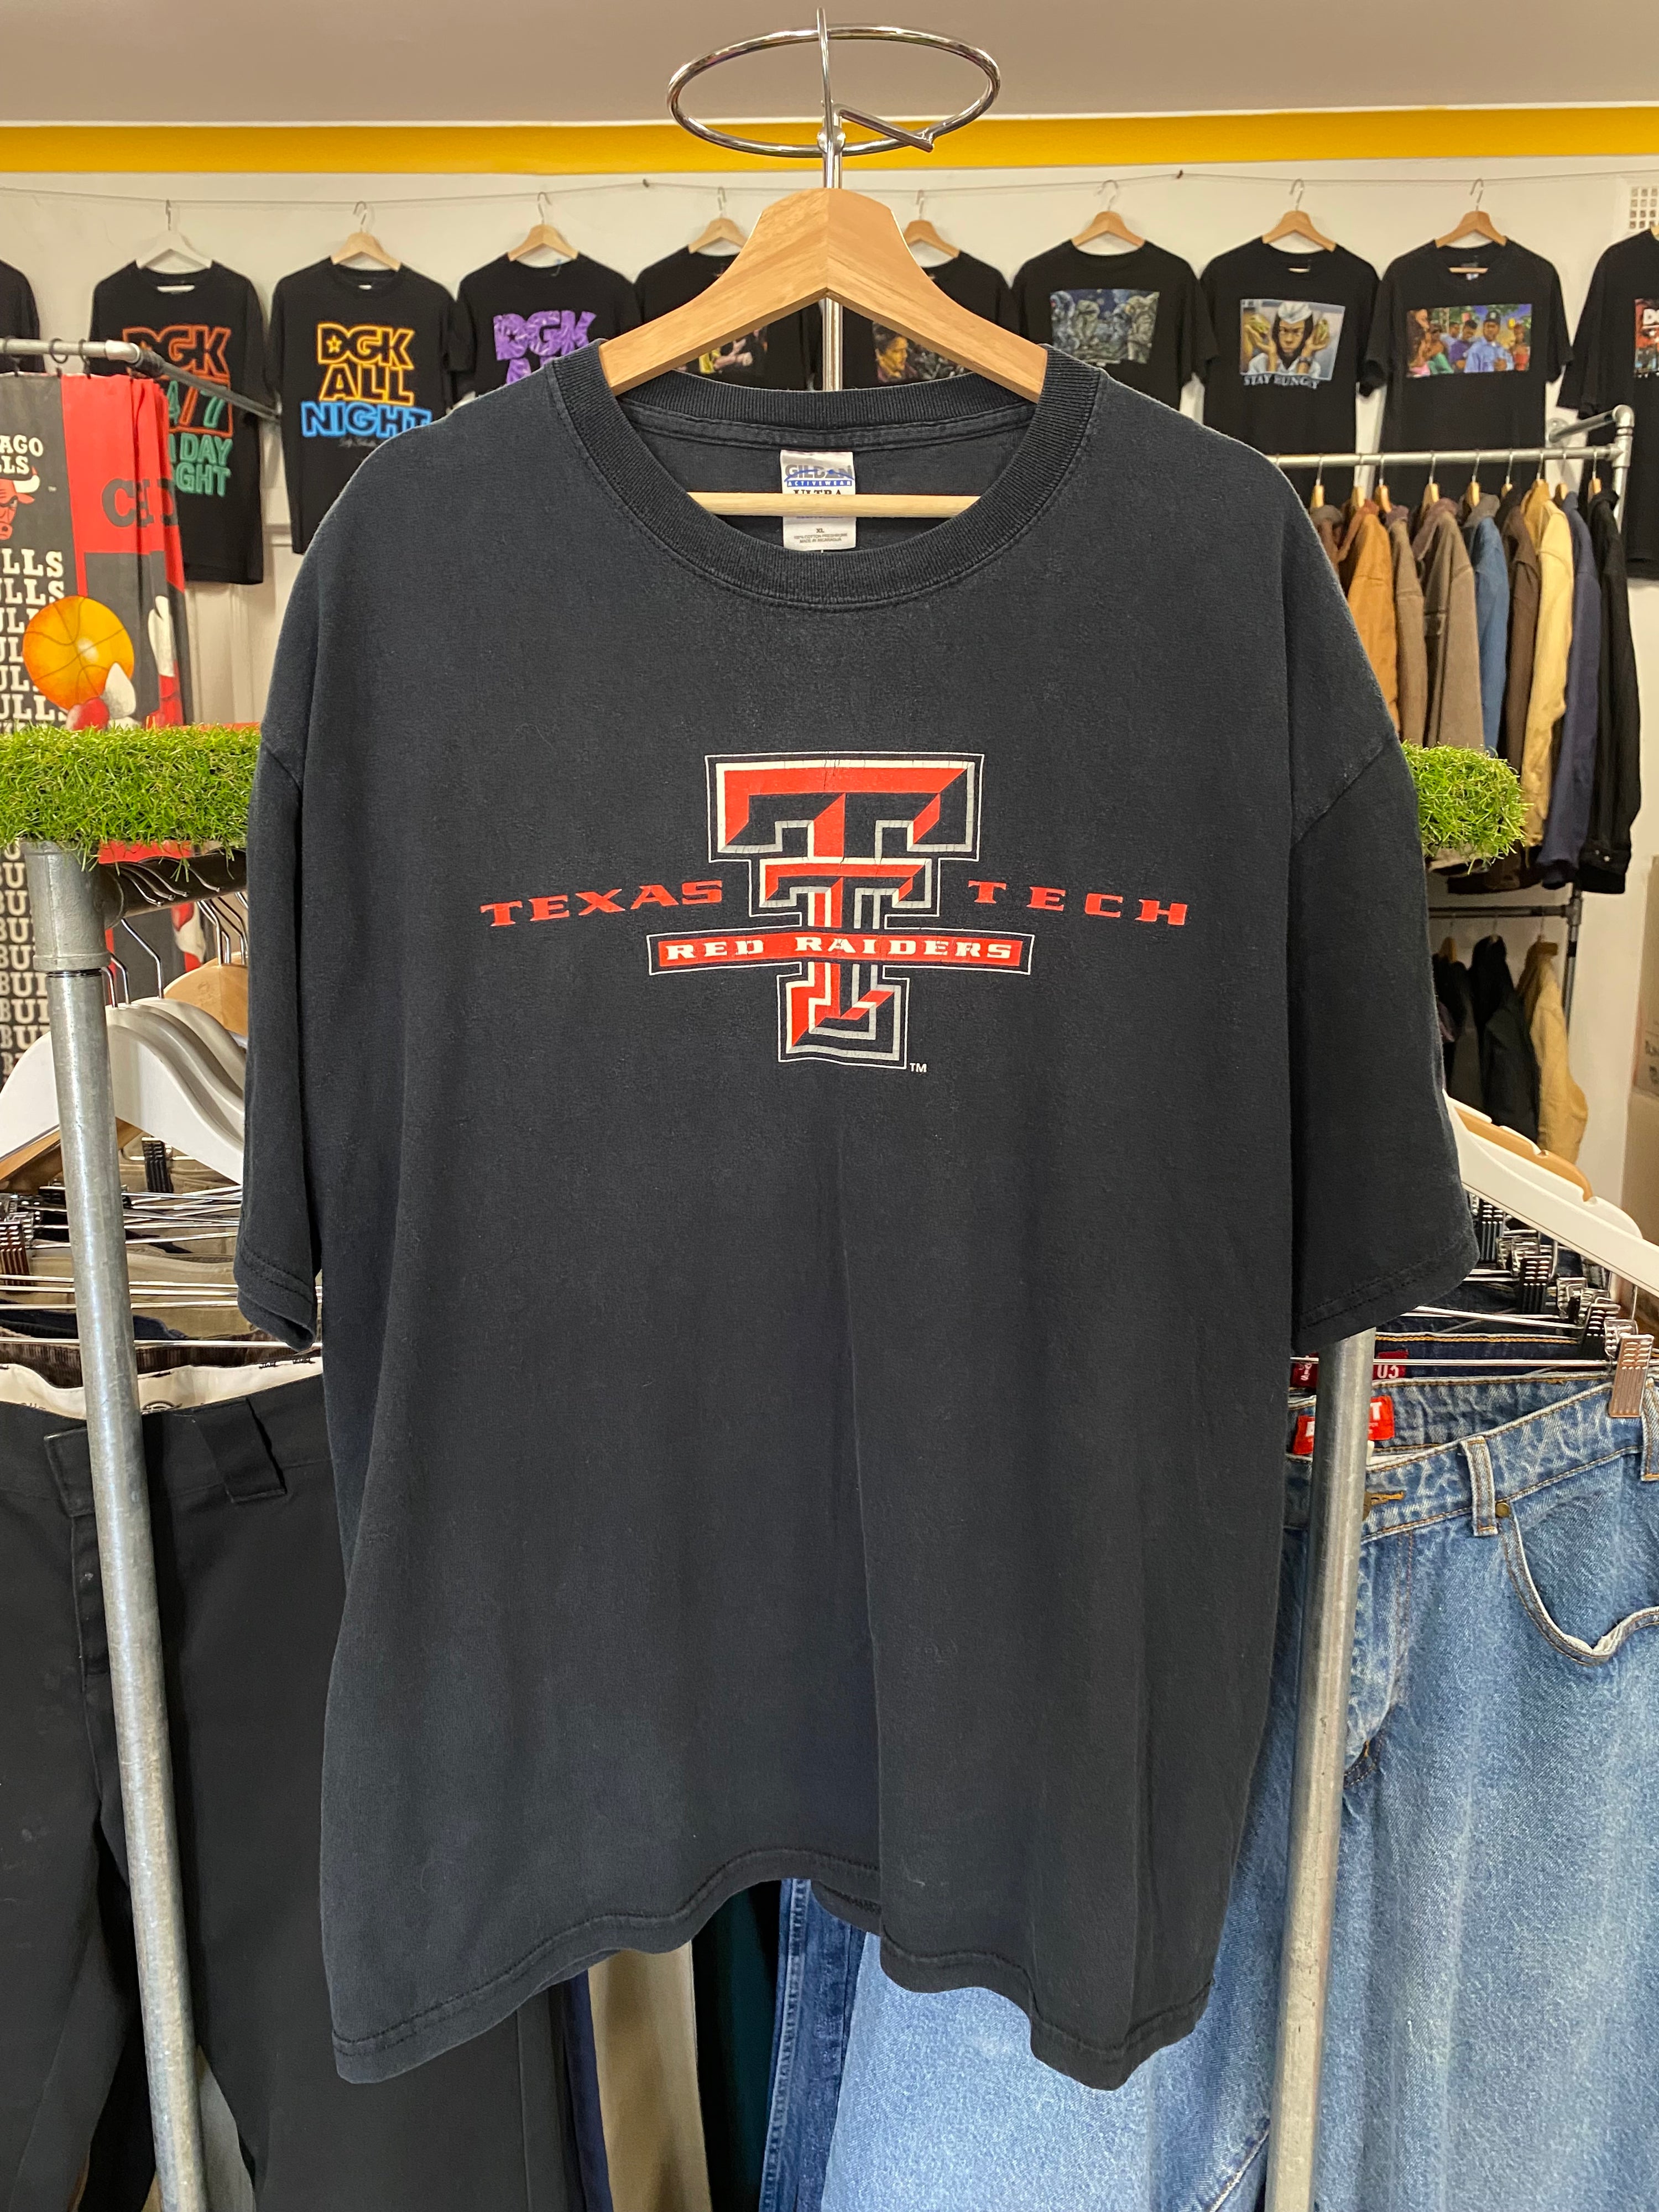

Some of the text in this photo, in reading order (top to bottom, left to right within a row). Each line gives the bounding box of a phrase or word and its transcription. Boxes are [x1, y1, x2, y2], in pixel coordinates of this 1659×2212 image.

[317, 322, 415, 370] DGK
[493, 310, 597, 361] DGK
[319, 362, 414, 406] ALL
[1244, 373, 1272, 386] STAY
[301, 400, 434, 439] NIGHT
[180, 433, 233, 467] DAY
[480, 880, 1188, 927] TEXAS TECH
[665, 936, 1011, 961] RED RAIDERS
[909, 1062, 927, 1073] TM
